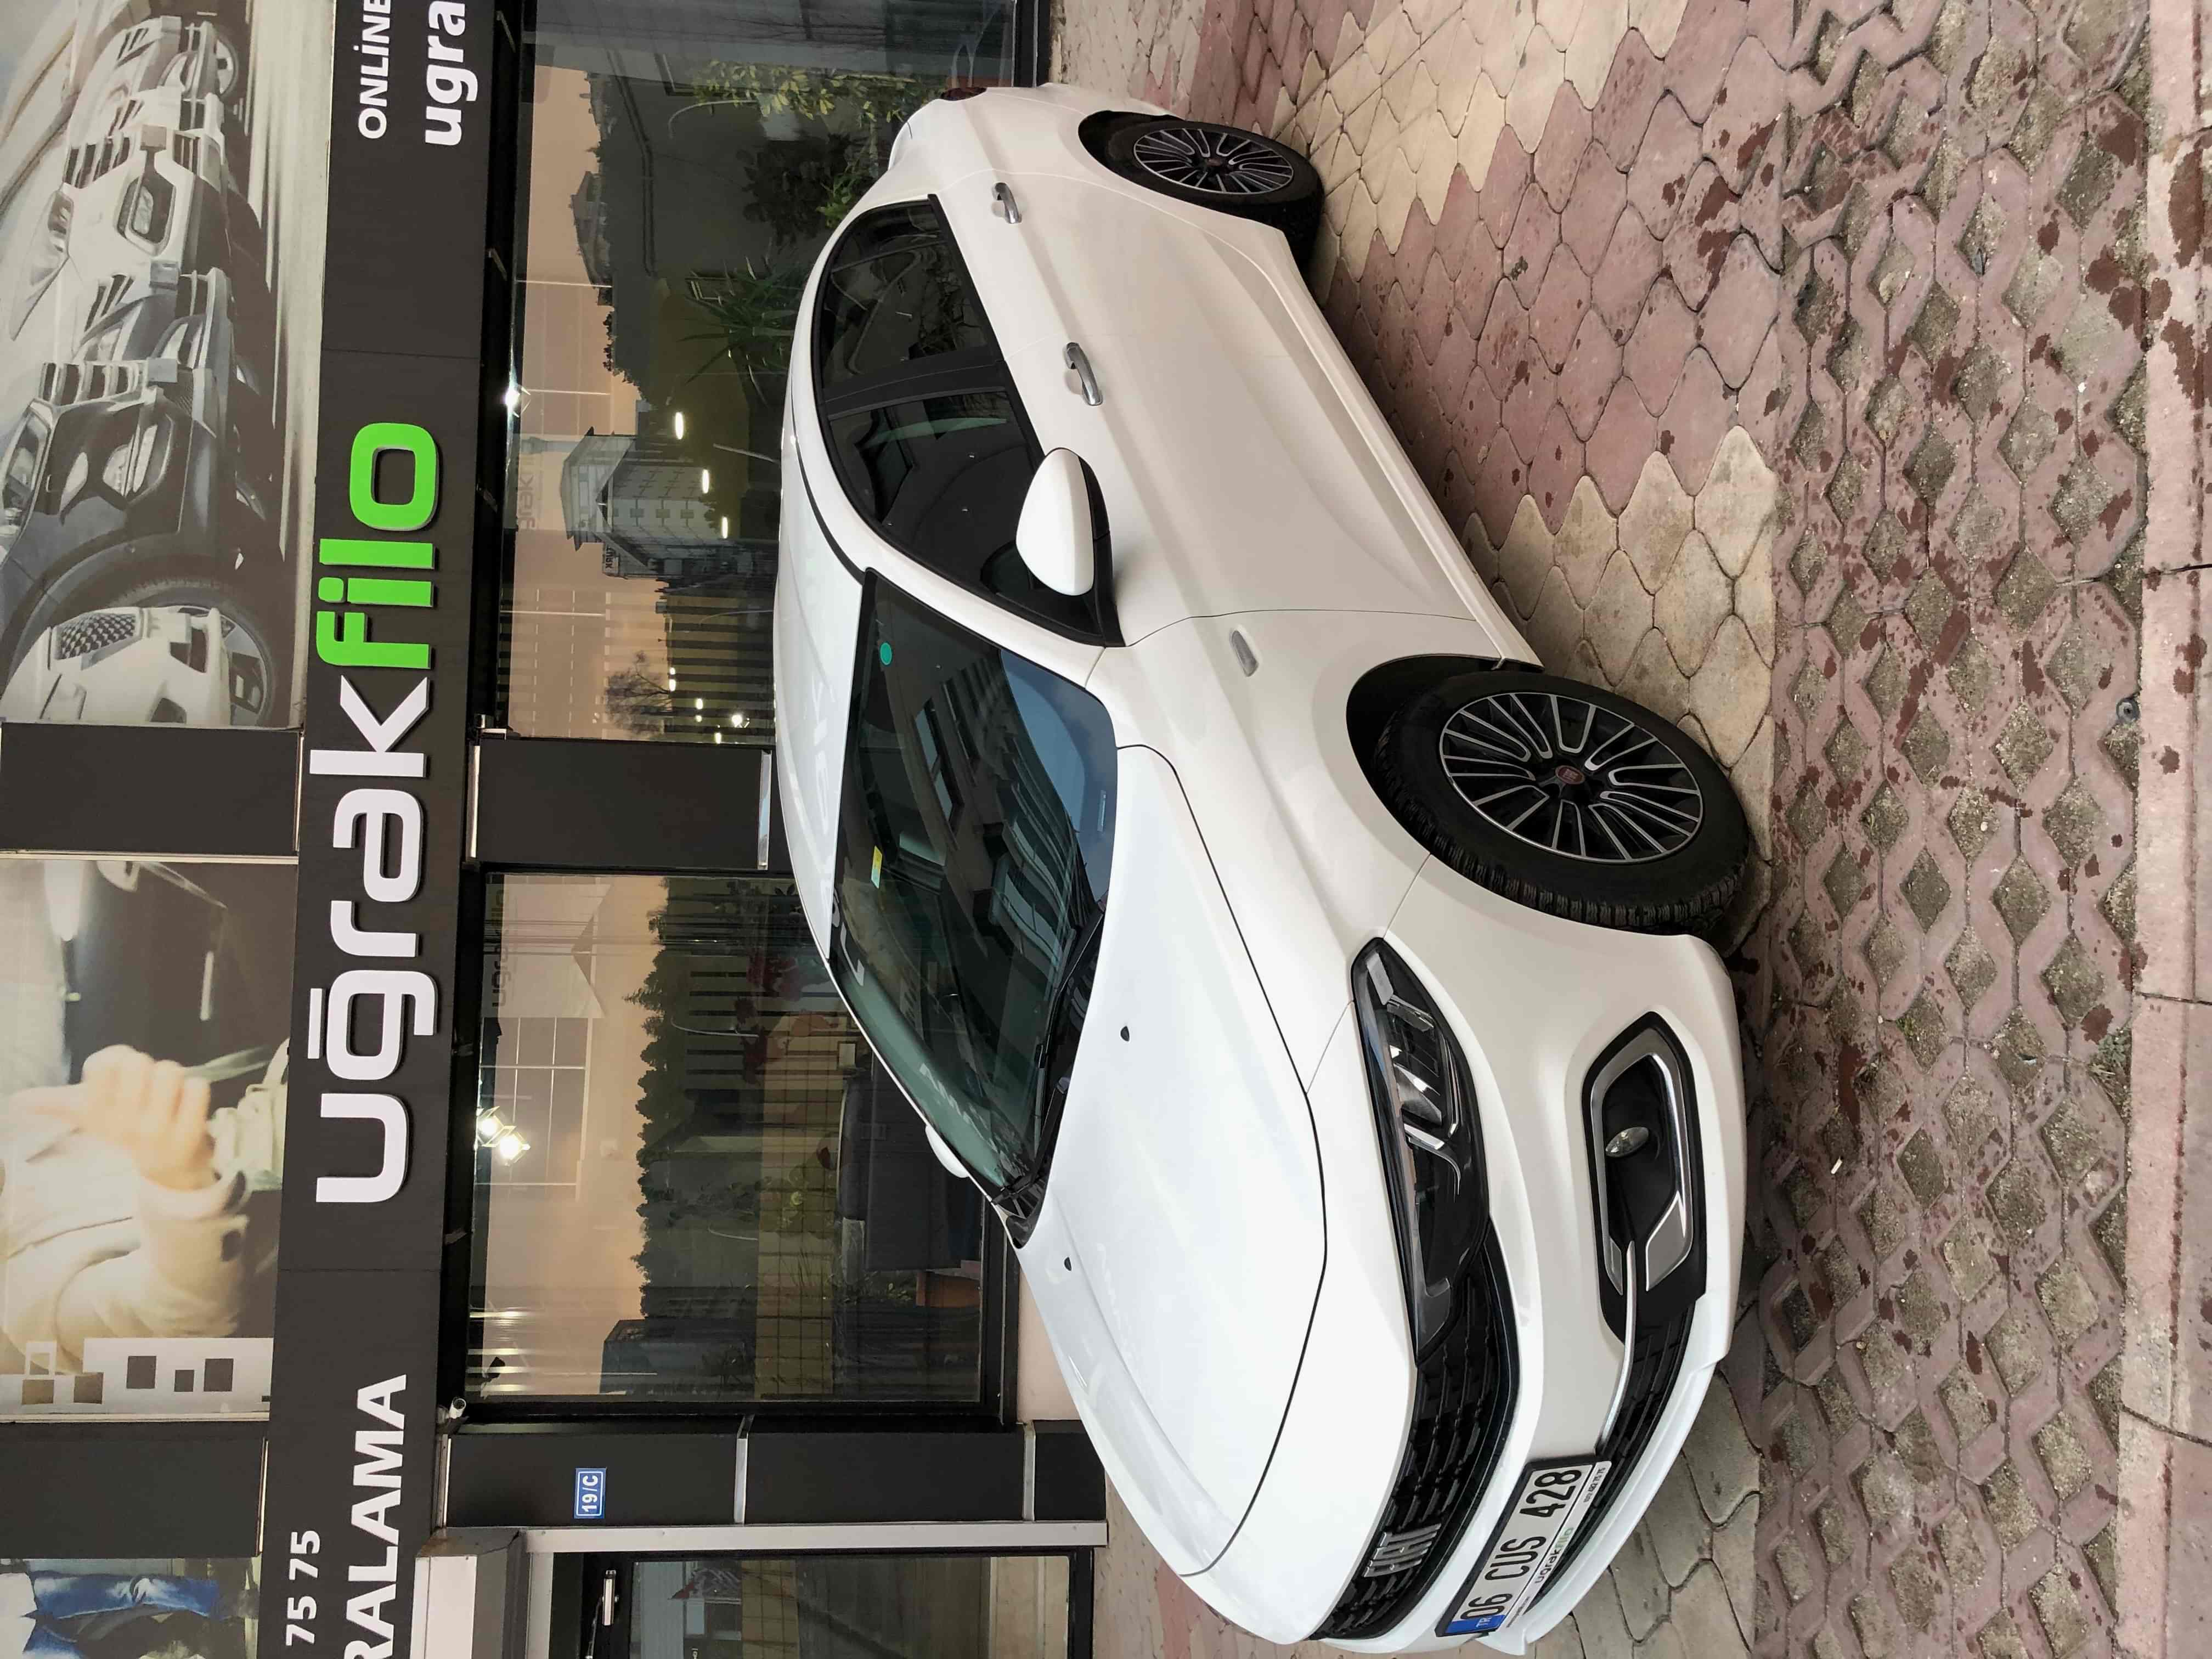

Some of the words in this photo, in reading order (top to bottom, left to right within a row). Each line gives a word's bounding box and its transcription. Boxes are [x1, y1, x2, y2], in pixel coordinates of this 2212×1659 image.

[582, 1475, 599, 1513] 19/C
[1519, 1470, 1582, 1517] 428
[289, 1530, 320, 1581] 75
[1363, 1523, 1442, 1577] FIAT
[1485, 1536, 1546, 1581] CUS
[286, 1596, 317, 1646] 75
[1460, 1593, 1513, 1620] 06
[1475, 1616, 1493, 1628] TR
